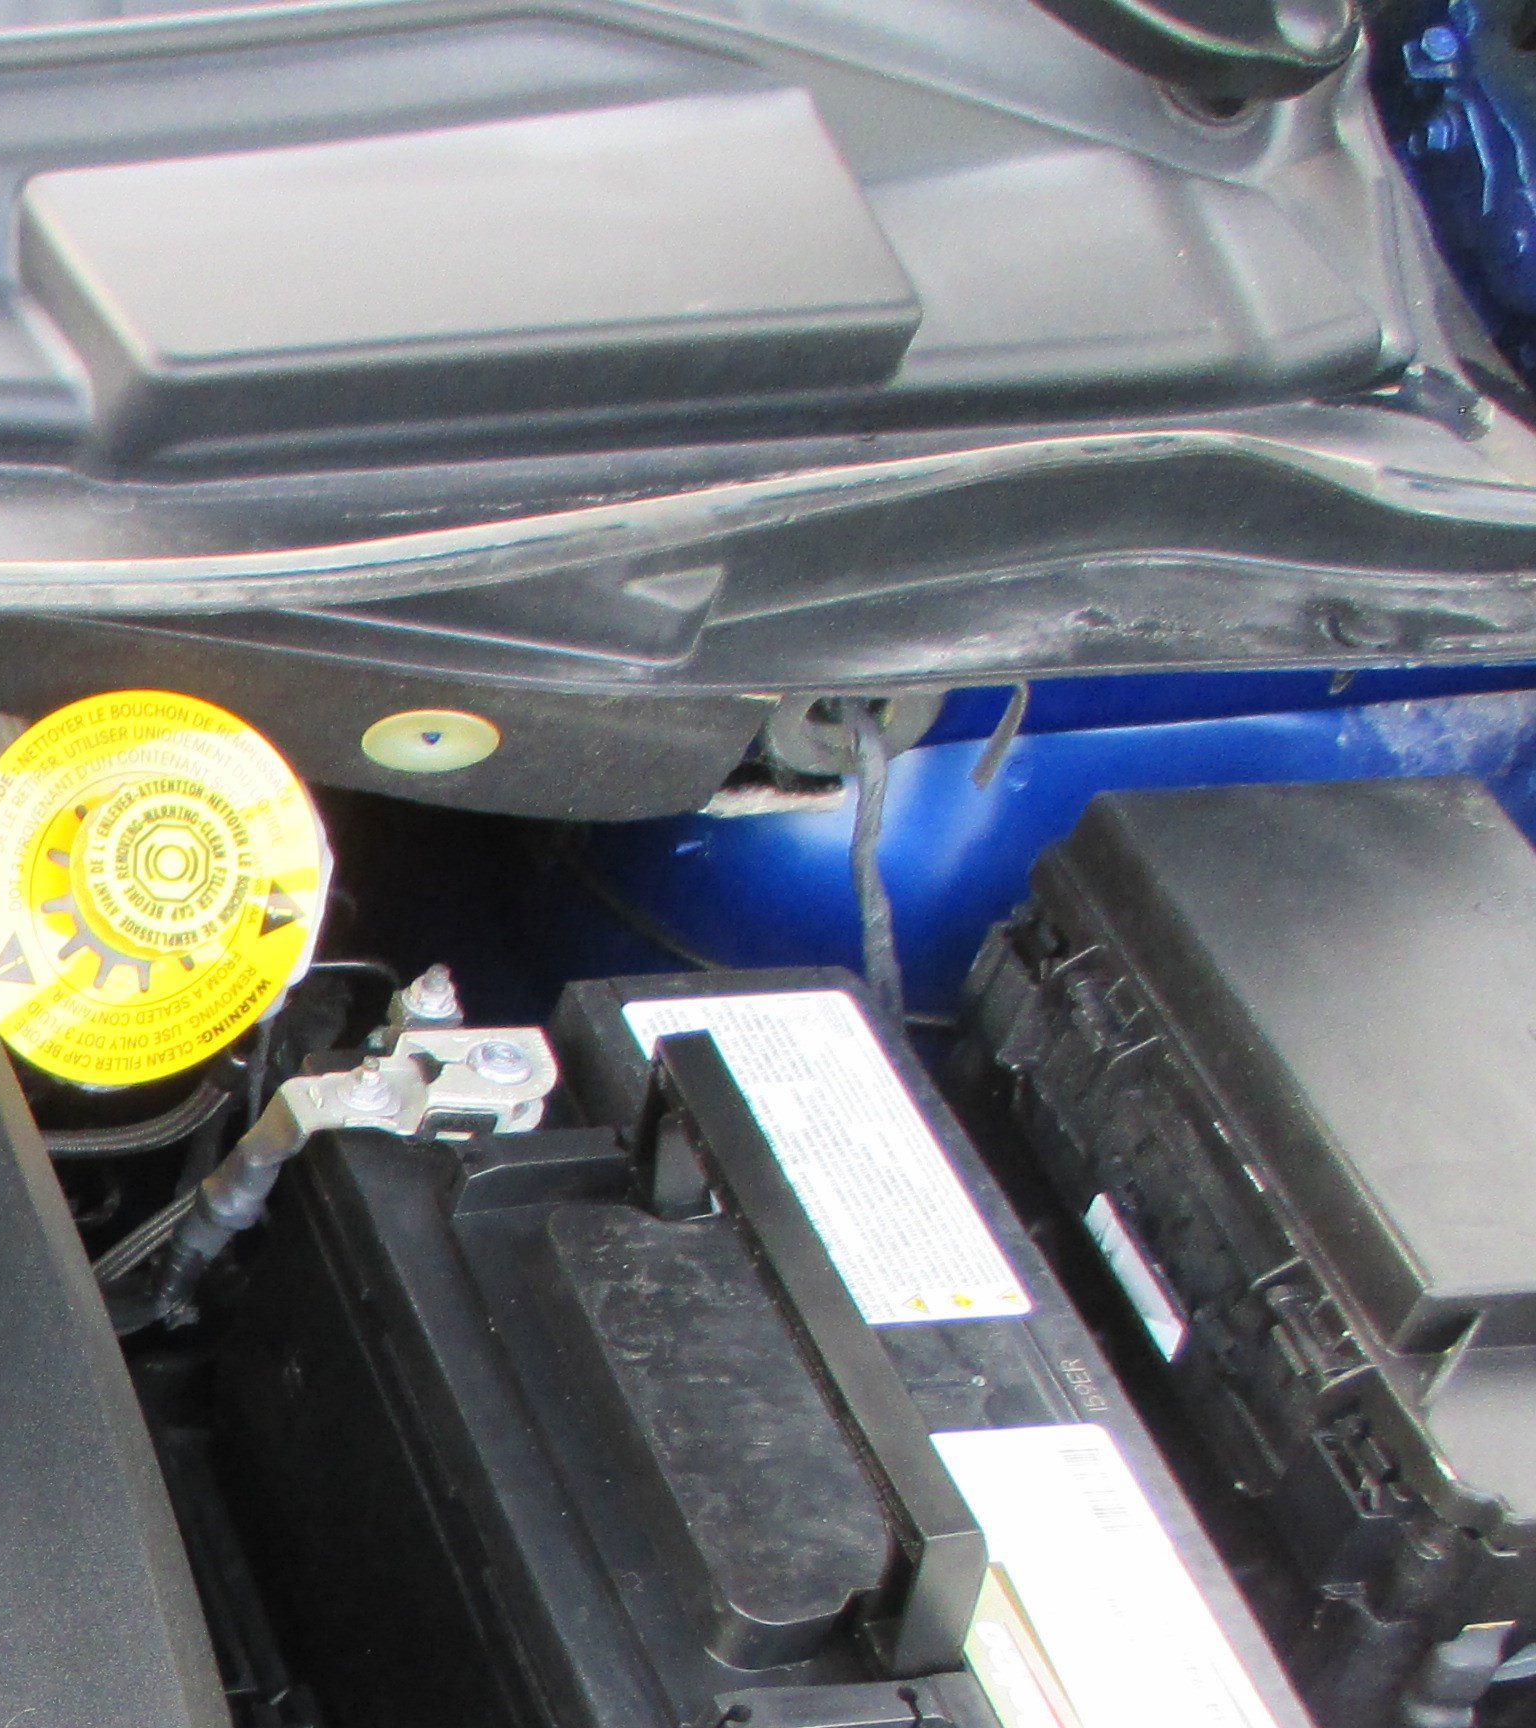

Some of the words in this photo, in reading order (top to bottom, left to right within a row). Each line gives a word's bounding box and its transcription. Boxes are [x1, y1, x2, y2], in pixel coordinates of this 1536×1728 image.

[16, 714, 85, 768] NETTOYER
[88, 707, 104, 724] LE
[110, 703, 189, 723] BOUCHON
[193, 712, 212, 732] DE
[64, 726, 128, 759] UTILISER
[133, 726, 232, 768] UNIQUEMENT
[14, 772, 73, 857] PROVENANT
[117, 749, 209, 779] CONTENANT
[206, 951, 242, 991] FROM
[53, 989, 131, 1026] CONTAINER
[191, 988, 203, 1000] A
[136, 995, 191, 1025] SEALED
[14, 1017, 63, 1059] BEFORE
[64, 1026, 75, 1040] 3
[76, 1031, 106, 1049] DOT
[109, 1034, 148, 1051] ONLY
[154, 1025, 182, 1045] USE
[62, 1053, 92, 1068] CAP
[94, 1054, 141, 1071] FILLER
[146, 1039, 194, 1067] CLEAN
